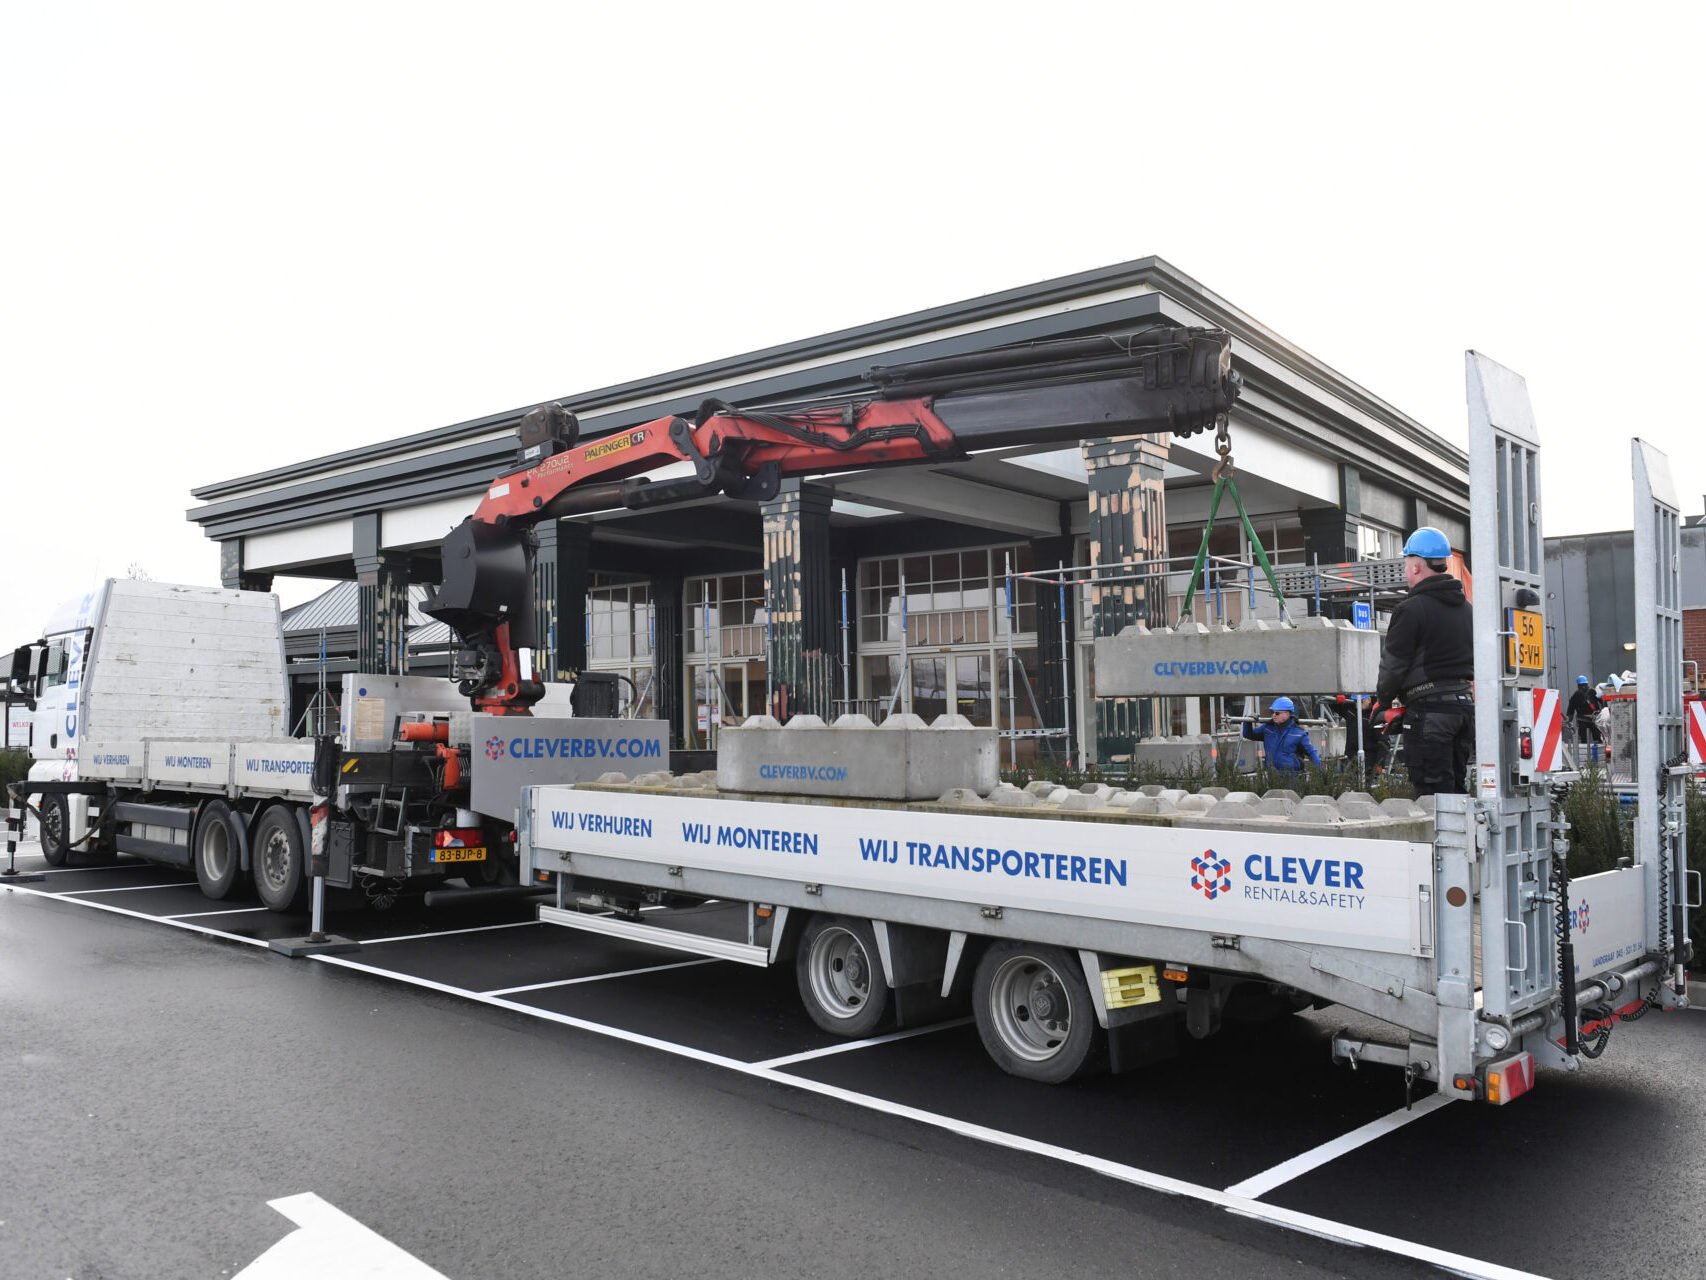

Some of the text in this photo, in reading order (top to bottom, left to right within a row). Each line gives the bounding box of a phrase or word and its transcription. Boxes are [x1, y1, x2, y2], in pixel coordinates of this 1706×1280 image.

[584, 430, 645, 460] PALFINGER CR
[1522, 615, 1534, 637] 56
[1154, 660, 1268, 676] CLEVERBV.COM
[509, 737, 662, 759] CLEVERBV.COM
[93, 754, 130, 766] WIJ VERHUREN
[165, 756, 212, 769] WIJ MONTEREN
[246, 758, 259, 772] WIJ
[760, 764, 848, 781] CLEVERBV.COM
[551, 810, 652, 838] WIJ VERHUREN
[682, 821, 818, 856] WIJ MONTEREN
[440, 849, 482, 861] 83-BJP-8
[858, 837, 1127, 887] WIJ TRANSPORTEREN
[1244, 853, 1366, 890] CLEVER
[1244, 885, 1366, 910] RENTAL&SAFETY
